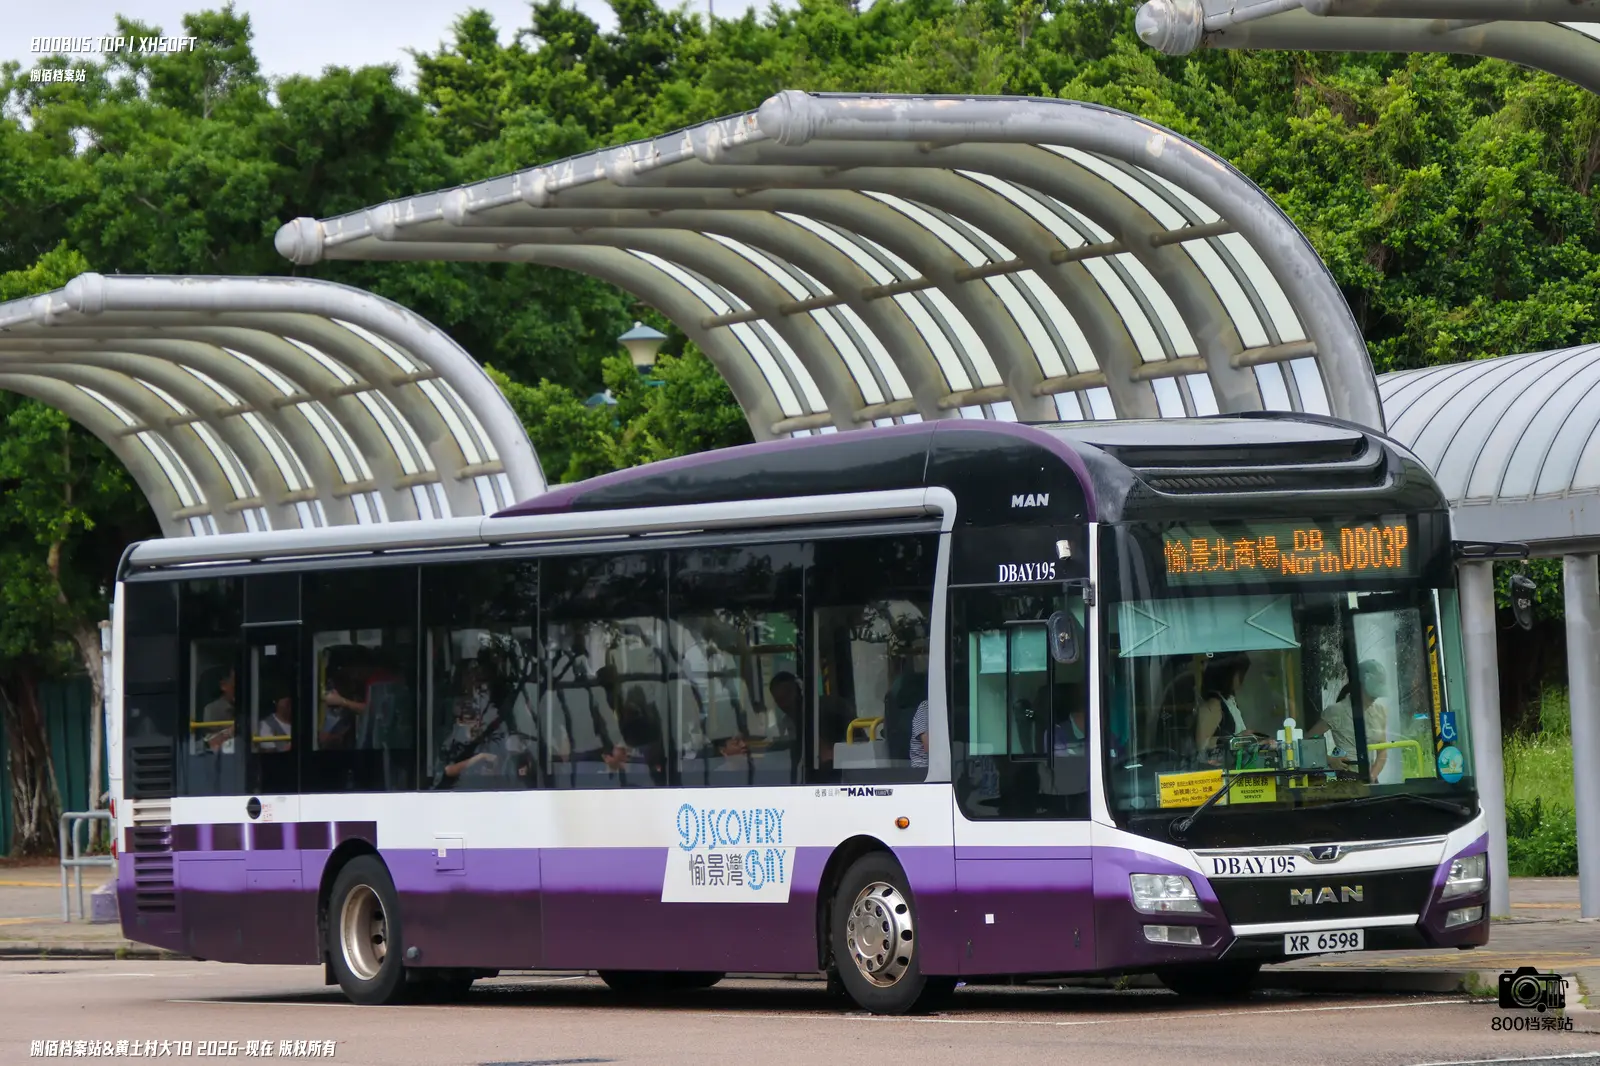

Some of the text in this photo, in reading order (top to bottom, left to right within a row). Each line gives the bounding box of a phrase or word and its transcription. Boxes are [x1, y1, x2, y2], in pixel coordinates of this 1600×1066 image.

[1011, 493, 1050, 508] MAN
[1293, 529, 1324, 551] DB
[1340, 525, 1408, 570] DB03P
[1164, 535, 1280, 573] 愉景北商場
[1281, 551, 1341, 576] North
[998, 562, 1056, 582] DBAY195
[848, 787, 874, 797] MAN
[677, 803, 785, 851] DISCOVERY
[689, 853, 743, 886] 愉景灣
[745, 848, 786, 890] BAY
[1212, 856, 1296, 875] DBAY195
[1290, 885, 1364, 906] MAN
[1290, 932, 1359, 952] XR 6598
